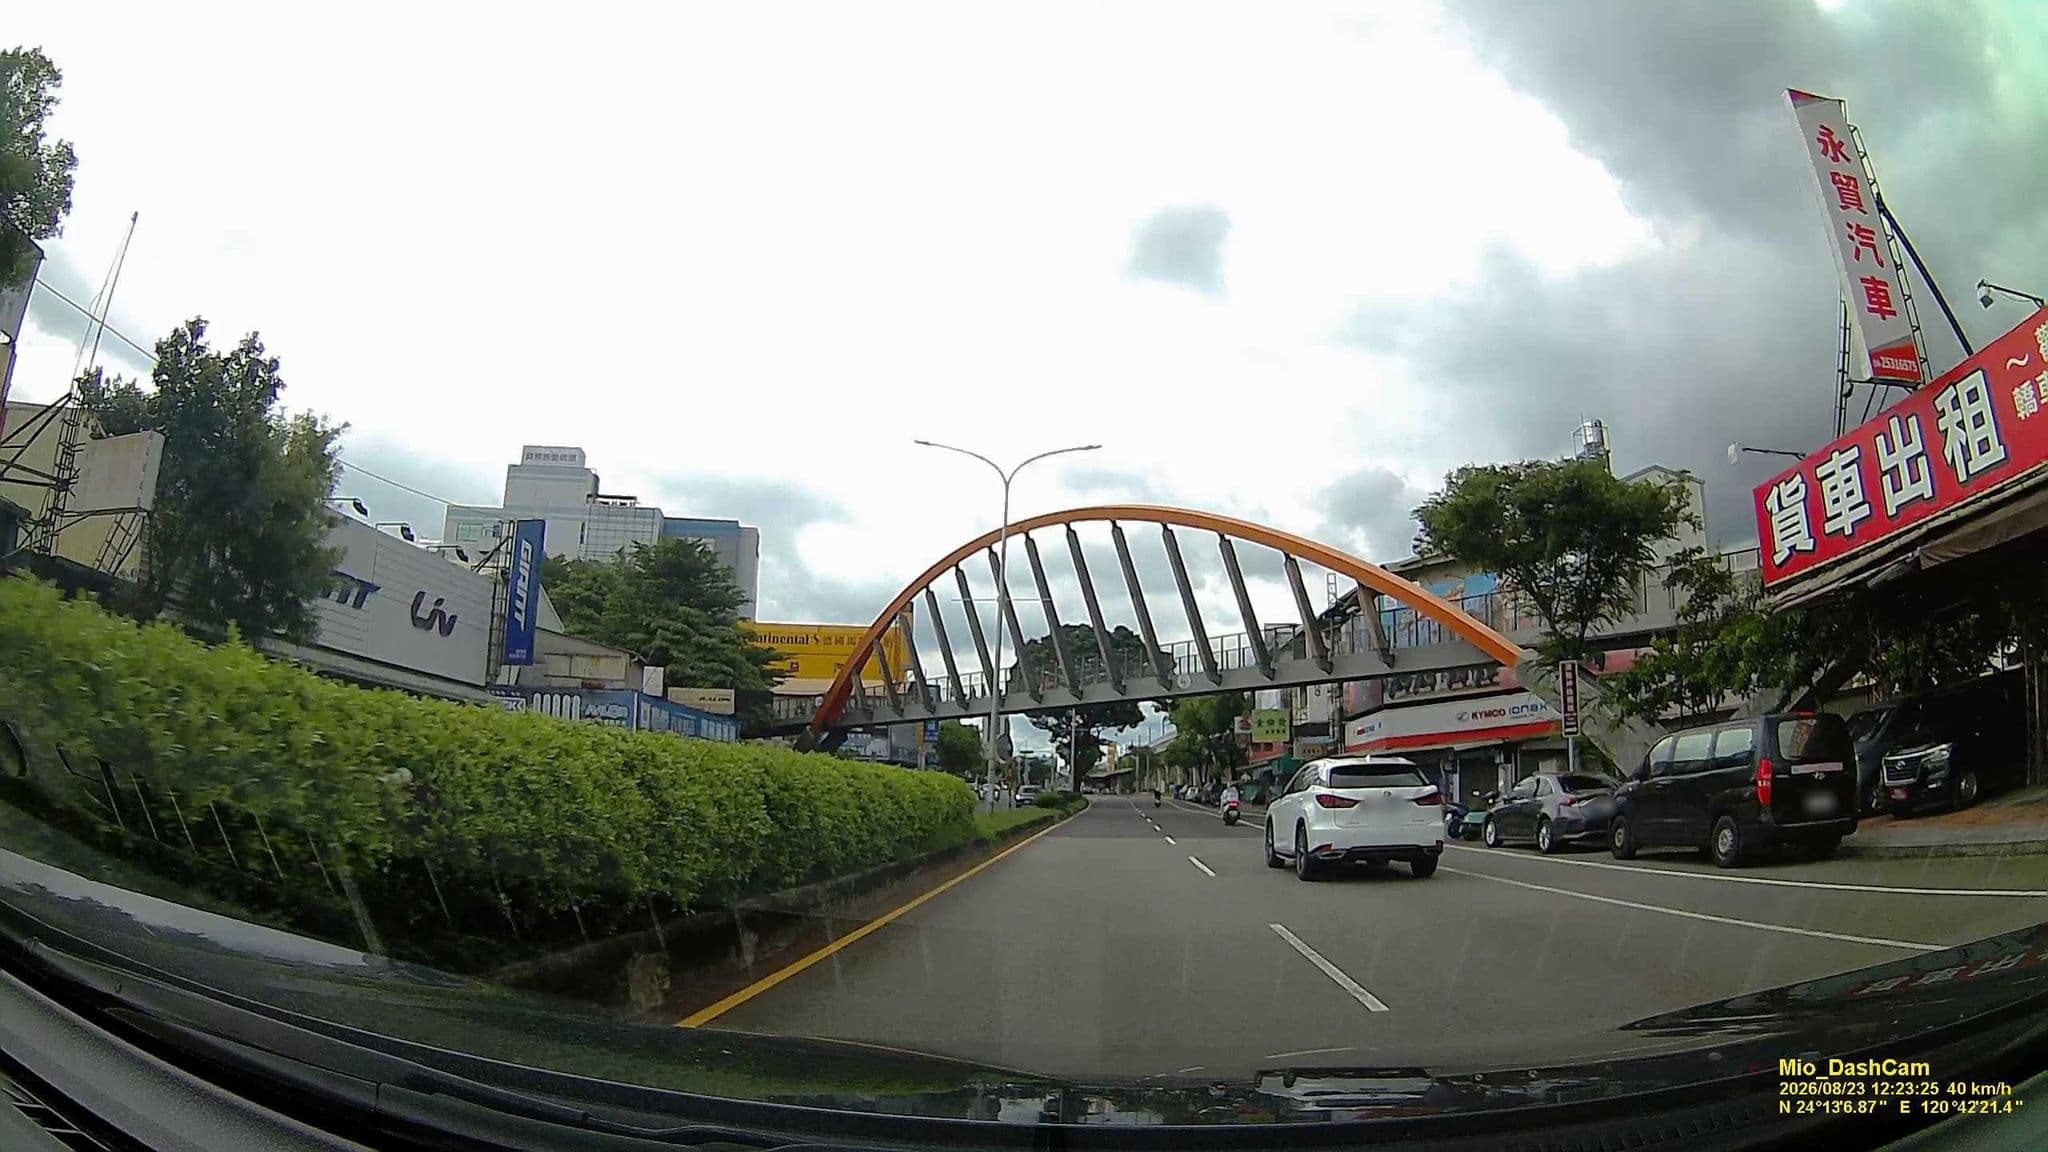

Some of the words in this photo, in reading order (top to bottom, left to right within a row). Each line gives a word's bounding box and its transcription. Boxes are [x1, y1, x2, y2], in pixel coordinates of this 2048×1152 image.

[1816, 123, 1897, 322] 永貿汽車
[1764, 367, 2007, 566] 貨車出租
[411, 591, 458, 638] Liv
[514, 539, 532, 632] GIANT
[1472, 709, 1506, 720] KYMCO
